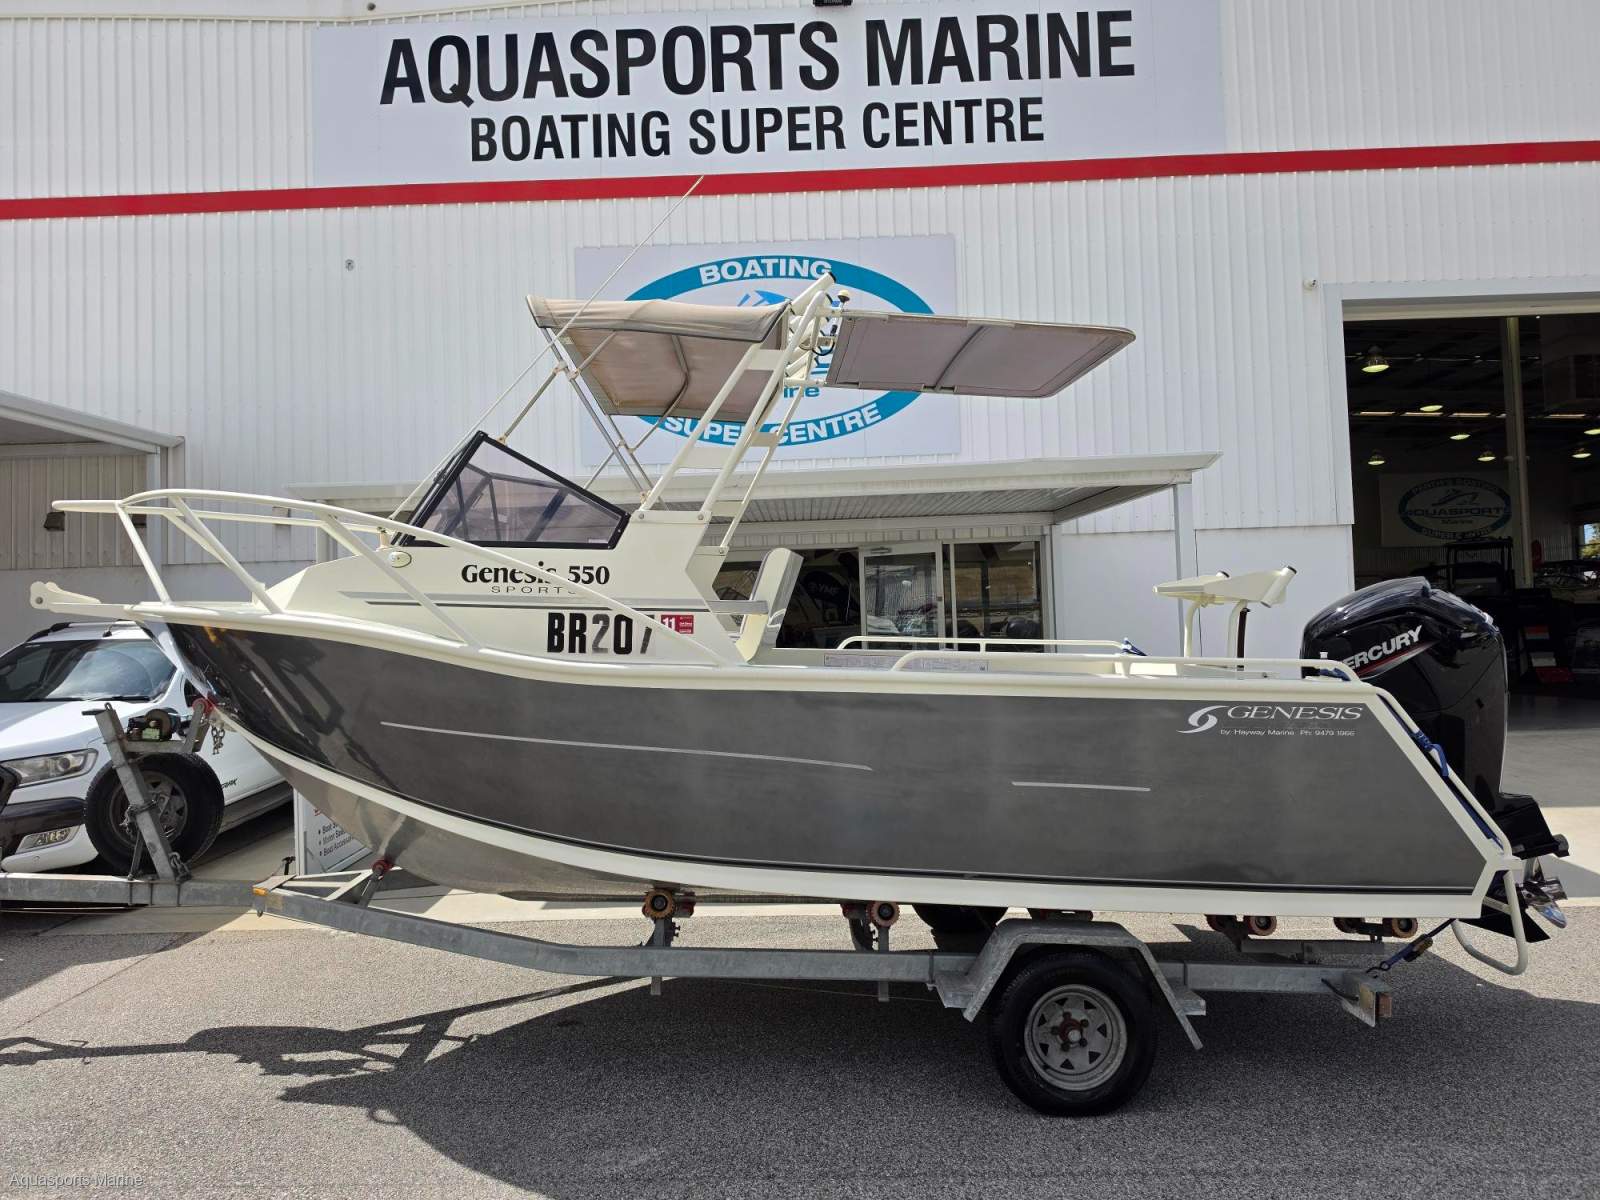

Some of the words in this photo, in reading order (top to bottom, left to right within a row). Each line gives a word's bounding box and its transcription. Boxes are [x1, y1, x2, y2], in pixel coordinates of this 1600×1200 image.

[380, 21, 839, 107] AQUASPORTS
[866, 10, 1135, 87] MARINE
[471, 110, 670, 161] BOATING
[689, 105, 845, 155] SUPER
[863, 97, 1044, 148] CENTRE
[700, 258, 832, 286] BOATING
[664, 416, 745, 444] SUPE
[567, 565, 610, 585] 550
[1341, 625, 1422, 670] ERCURY
[1227, 705, 1364, 720] GENESIS
